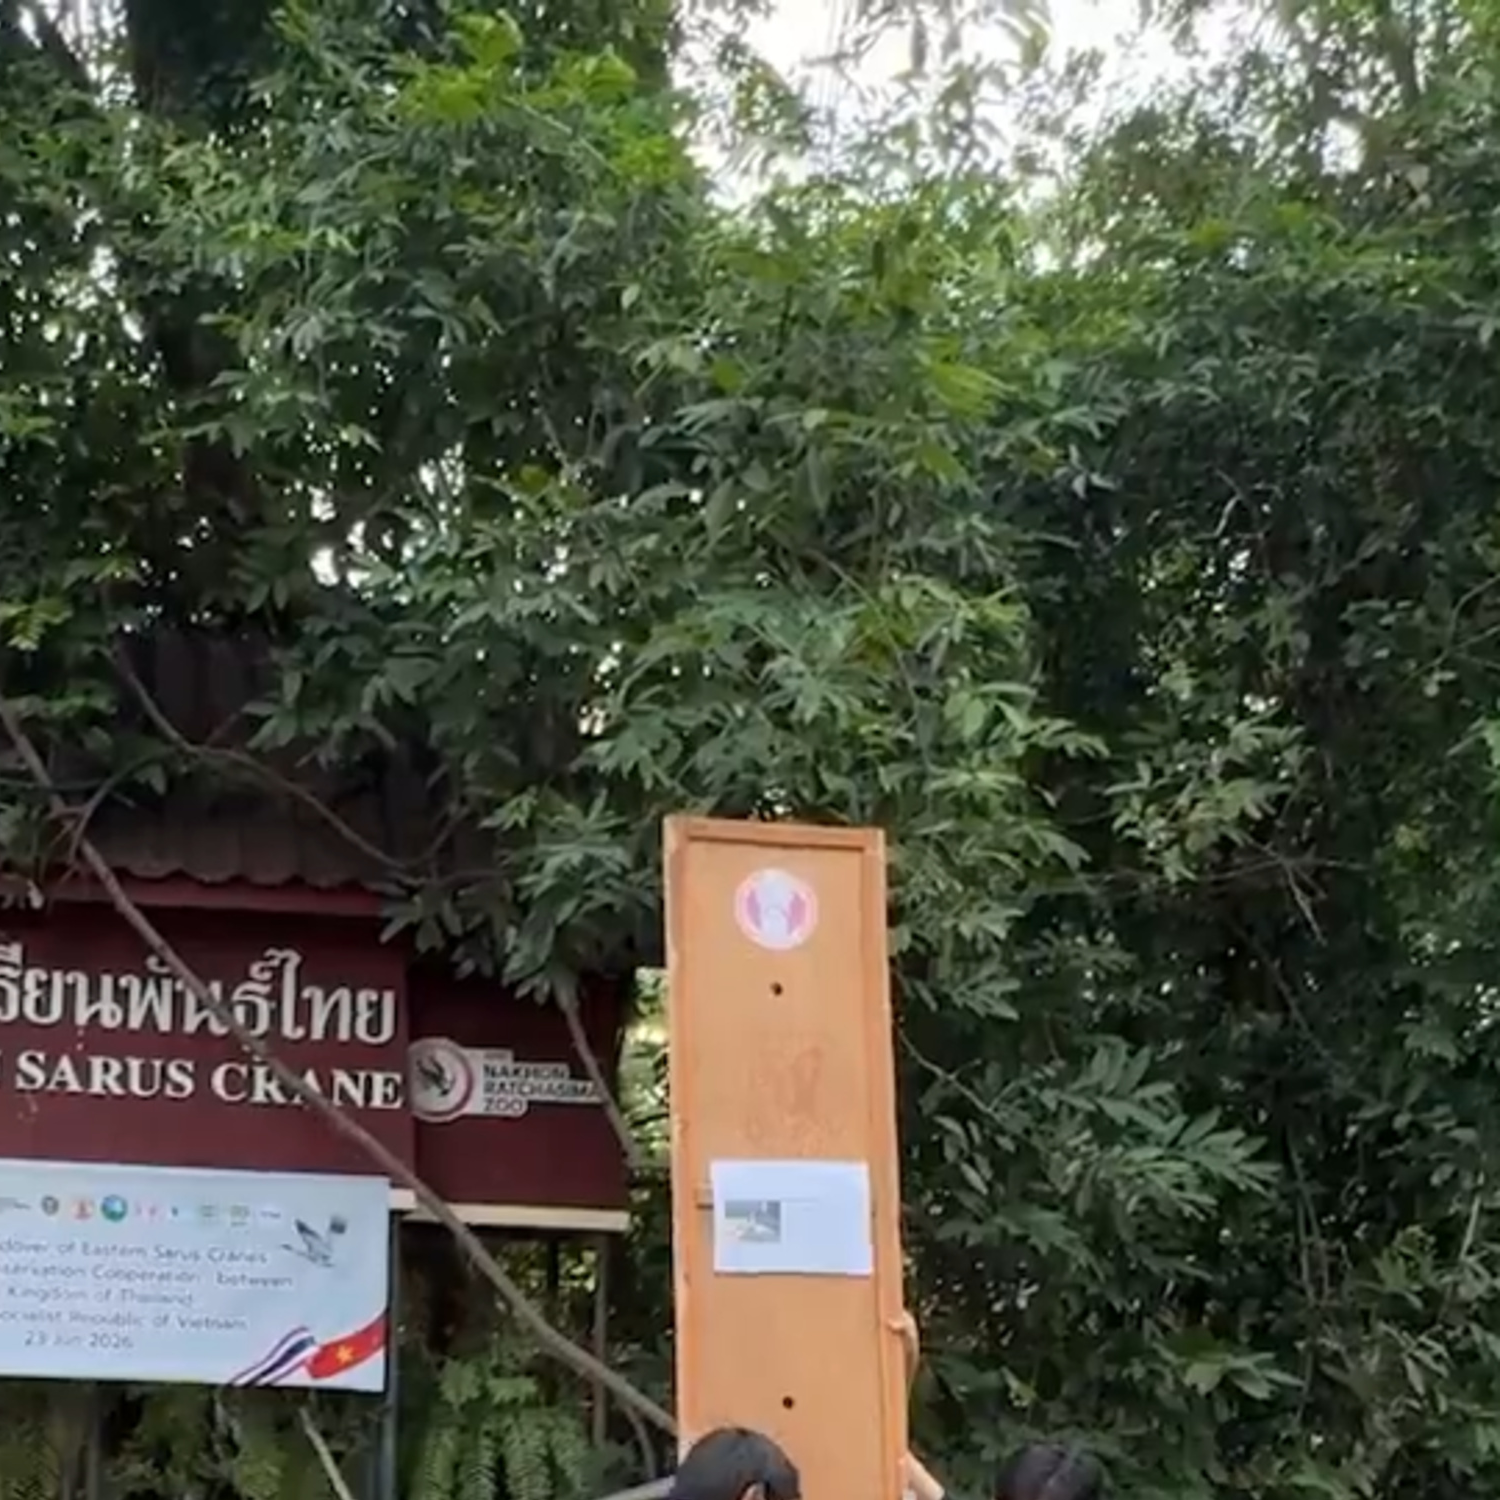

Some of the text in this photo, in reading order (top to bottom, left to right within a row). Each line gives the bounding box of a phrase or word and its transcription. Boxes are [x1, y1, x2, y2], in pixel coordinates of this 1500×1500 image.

[15, 1051, 197, 1099] SARUS
[483, 1063, 566, 1081] NAKHON
[484, 1098, 524, 1113] ZOO
[56, 1240, 76, 1256] of
[81, 1240, 148, 1258] Eastern
[153, 1243, 202, 1262] Sarus
[206, 1246, 268, 1265] Cranes
[91, 1263, 199, 1284] Cooperation
[215, 1270, 294, 1287] between
[6, 1284, 87, 1304] Kingdom
[94, 1287, 113, 1303] of
[151, 1313, 171, 1329] of
[176, 1315, 250, 1333] Vietnam
[23, 1329, 49, 1347] 23
